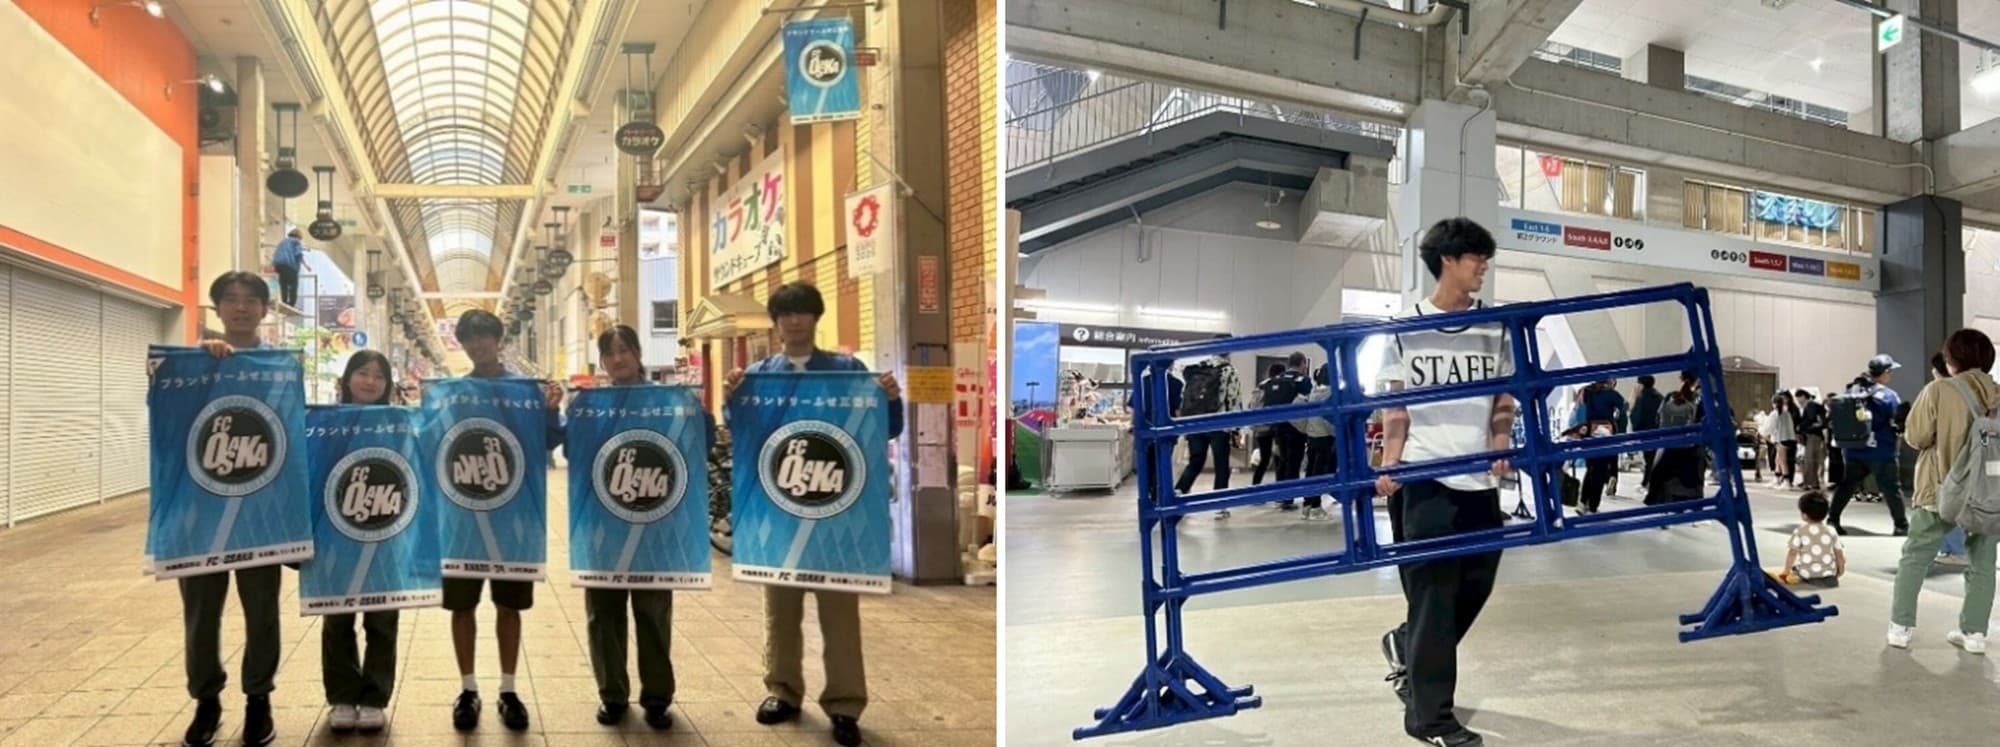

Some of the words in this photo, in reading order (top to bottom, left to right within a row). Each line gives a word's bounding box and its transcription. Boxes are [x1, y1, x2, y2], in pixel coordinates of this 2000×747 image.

[713, 172, 782, 254] カラオケ
[1411, 355, 1496, 387] STAFF
[211, 415, 233, 433] FC
[203, 432, 269, 476] OSAKA
[618, 448, 637, 464] FC
[787, 438, 809, 455] FC
[351, 466, 371, 482] FC
[609, 463, 669, 503] OSAKA
[777, 454, 845, 497] OSAKA
[342, 481, 402, 522] OSAKA
